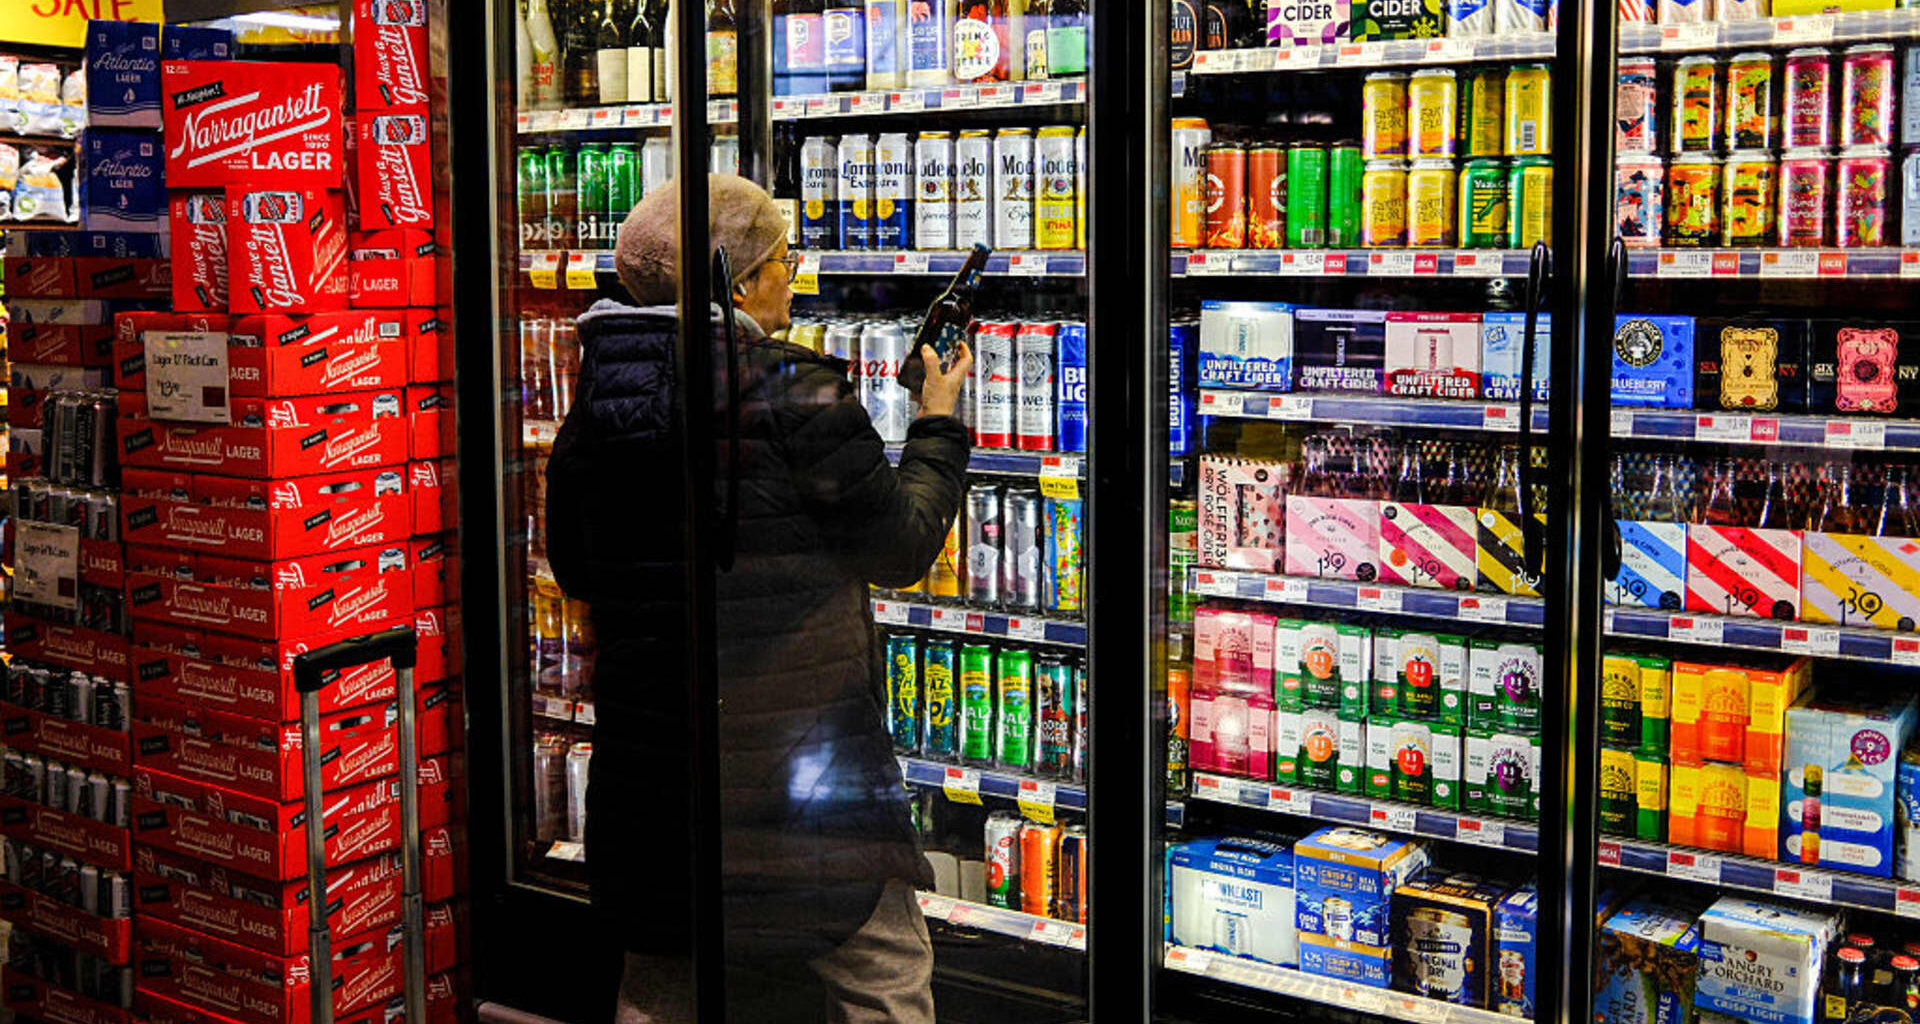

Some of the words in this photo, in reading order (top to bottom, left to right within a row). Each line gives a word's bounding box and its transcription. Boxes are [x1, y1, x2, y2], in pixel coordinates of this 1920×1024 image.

[1284, 5, 1332, 21] CIDER
[1369, 1, 1422, 16] CIDER
[93, 51, 156, 71] Atlantic
[170, 82, 331, 160] Narragansett
[302, 133, 331, 142] SINCE
[92, 157, 151, 178] Atlantic
[252, 151, 331, 170] LAGER
[1714, 260, 1736, 269] LOCAL
[1820, 260, 1843, 269] LOCAL
[363, 279, 399, 290] LAGER
[230, 367, 260, 380] AGER
[320, 345, 381, 387] Narragansett
[1170, 348, 1180, 393] LIGHT
[1206, 359, 1277, 372] UNFILTERED
[1302, 366, 1376, 379] UNFILTERED
[1814, 363, 1834, 372] SIX
[1899, 366, 1918, 379] NY
[351, 376, 381, 386] LAGER
[1201, 370, 1241, 382] CRAFT
[1244, 372, 1282, 384] CIDER
[1300, 377, 1337, 388] CRAFT
[1341, 379, 1378, 390] CIDER
[1396, 375, 1470, 388] UNFILTERED
[1391, 385, 1432, 396] CRAFT
[1437, 387, 1475, 399] CIDER
[1170, 395, 1179, 427] BUD
[320, 422, 381, 467] Narragansett
[226, 447, 261, 459] LAGER
[351, 454, 381, 465] LAGER
[323, 501, 384, 548] Narragansett
[228, 526, 263, 542] LAGER
[354, 533, 384, 544] LAGER
[1317, 549, 1346, 576] 139
[1411, 556, 1441, 584] 139
[1614, 576, 1647, 606] 139
[328, 579, 388, 626] Narragansett
[1725, 584, 1759, 615] 139
[1838, 586, 1883, 626] 139
[232, 607, 268, 623] LAGER
[357, 609, 388, 622] LAGER
[239, 687, 274, 704] LAGER
[365, 686, 394, 700] LAGER
[239, 765, 273, 782] LAGER
[364, 762, 394, 777] LAGER
[236, 844, 271, 863] LAGER
[362, 838, 392, 854] LAGER
[366, 910, 395, 926] LAGER
[241, 922, 277, 940] LAGER
[1727, 957, 1774, 977] ANGRY
[1714, 965, 1785, 993] ORCHARD
[367, 985, 395, 1001] LAGER
[242, 999, 279, 1019] LAGER
[1713, 999, 1747, 1012] CRISP
[1750, 1005, 1785, 1023] LIGHT
